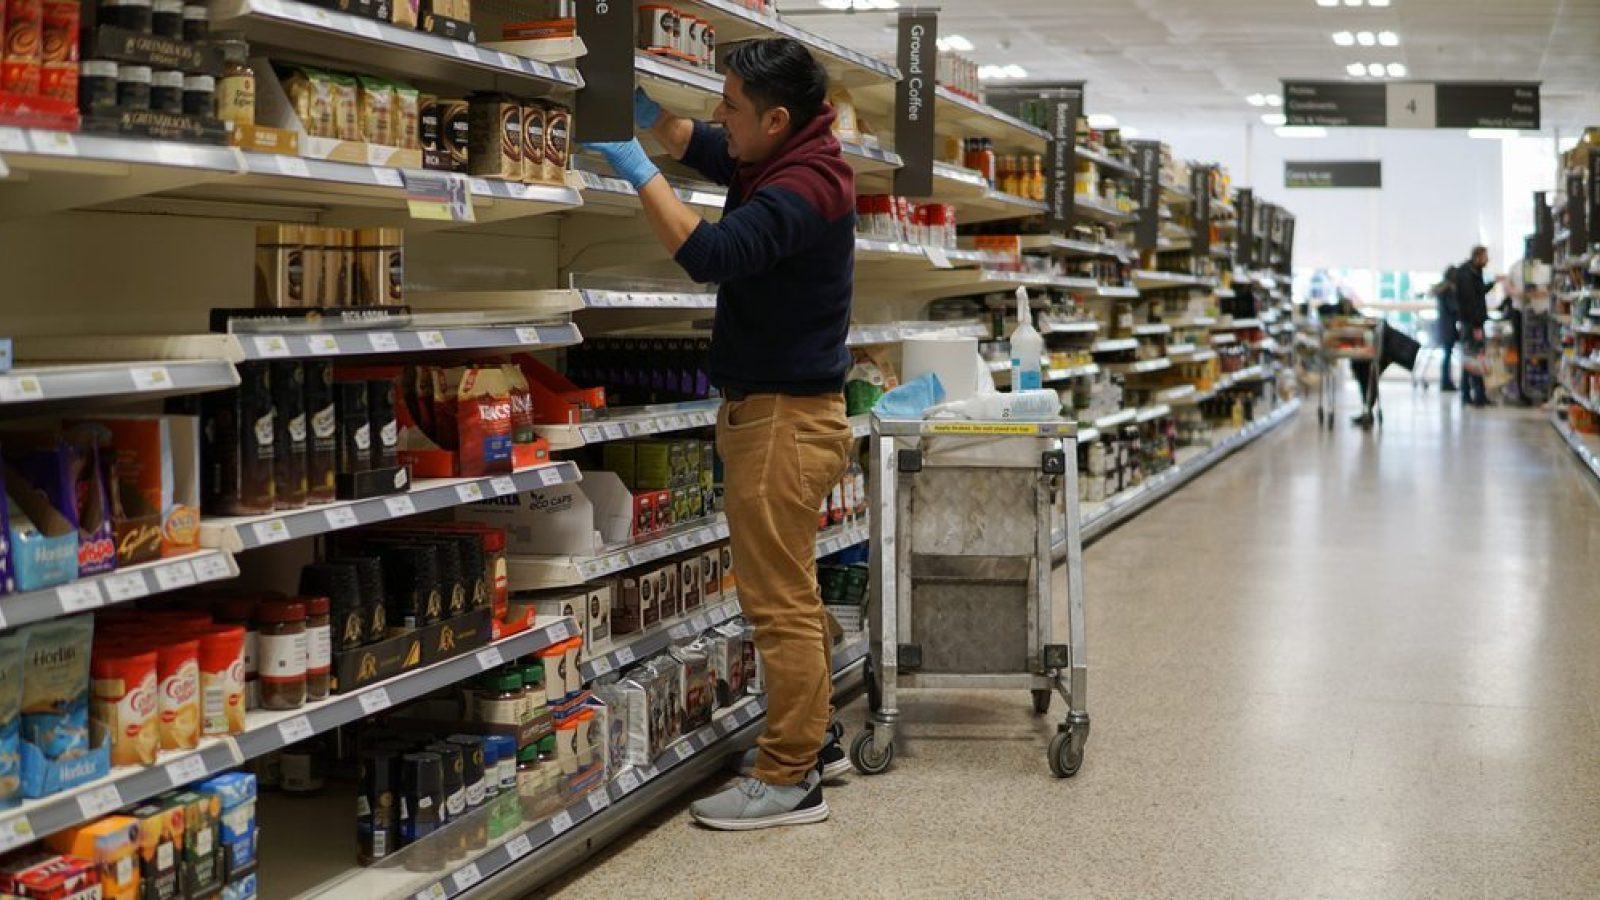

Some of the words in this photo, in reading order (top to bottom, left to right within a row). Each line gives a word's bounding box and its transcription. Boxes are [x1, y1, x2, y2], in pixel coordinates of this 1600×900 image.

[909, 24, 925, 74] Ground
[908, 78, 923, 121] Coffee
[1405, 98, 1417, 115] 4
